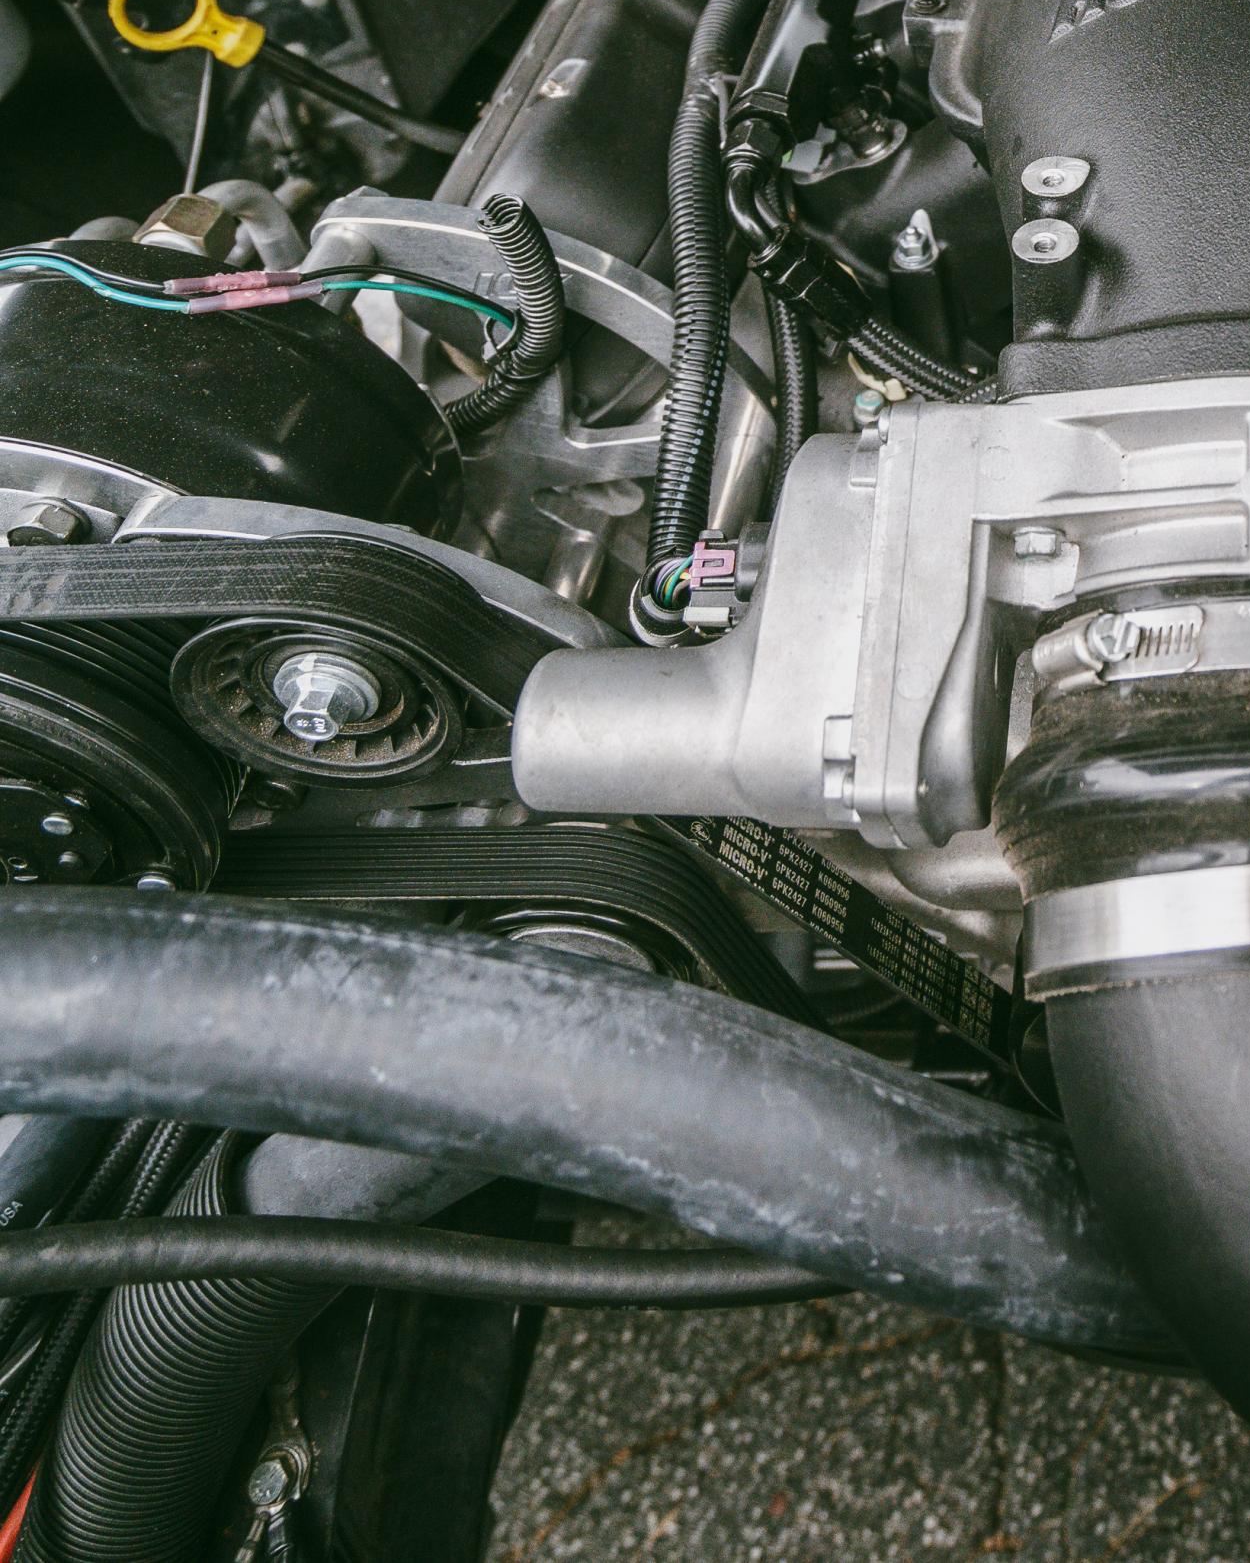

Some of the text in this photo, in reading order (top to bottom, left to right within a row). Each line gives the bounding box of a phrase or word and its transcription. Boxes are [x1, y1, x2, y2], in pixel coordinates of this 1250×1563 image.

[775, 860, 810, 891] 6PK2427
[772, 877, 808, 907] 6PK2427
[0, 1200, 24, 1227] USA
